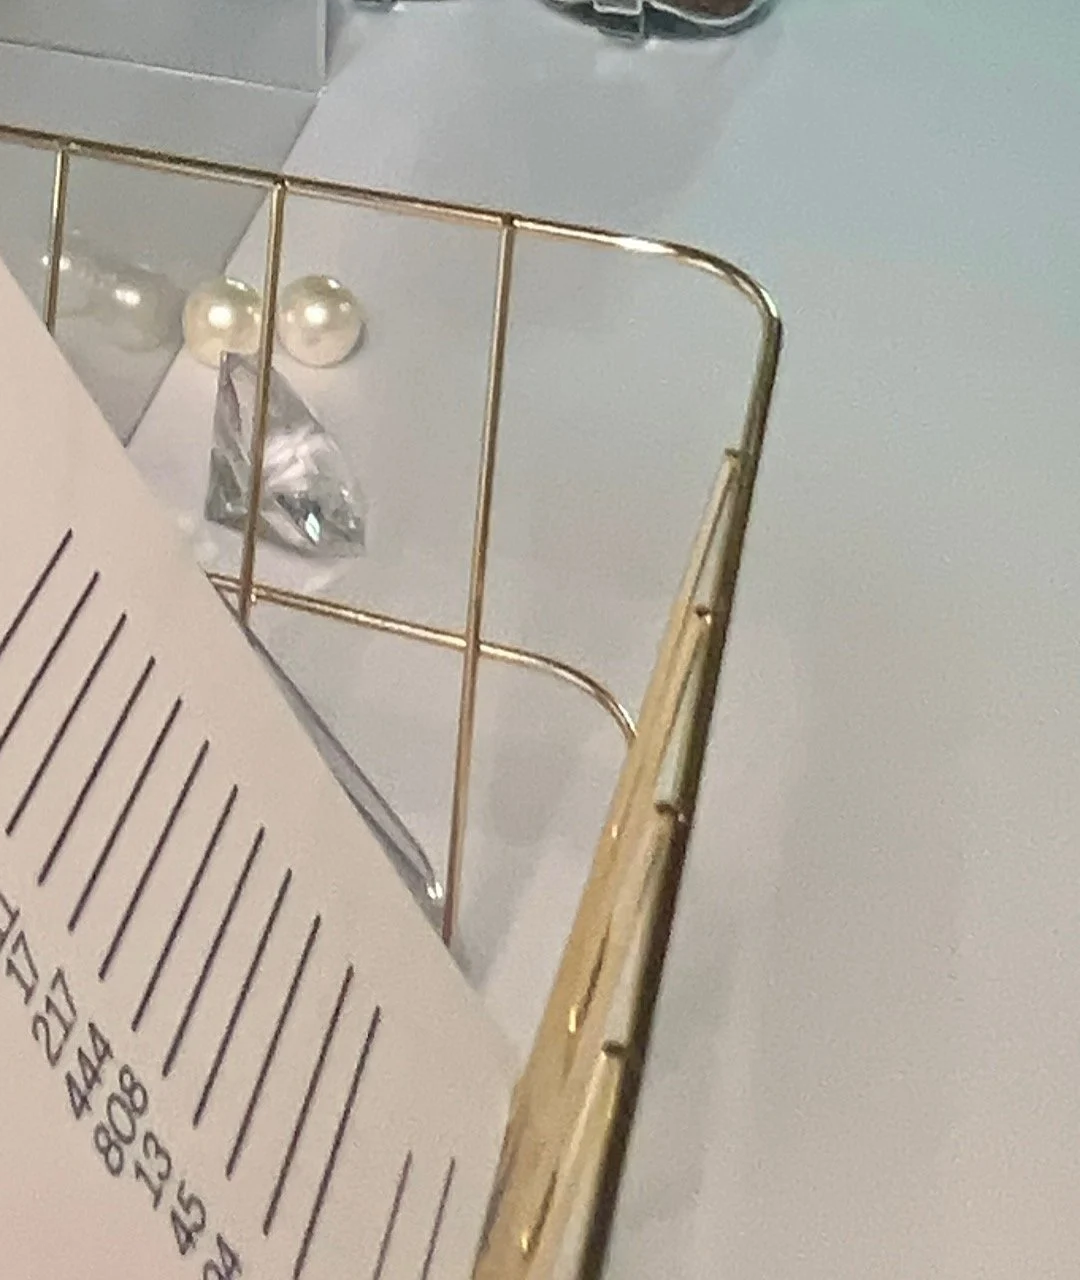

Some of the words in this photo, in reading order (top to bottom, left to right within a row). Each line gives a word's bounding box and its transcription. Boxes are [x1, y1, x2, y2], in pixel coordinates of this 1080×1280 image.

[5, 930, 40, 1006] 17
[31, 966, 78, 1068] 217
[65, 1021, 115, 1121] 444
[93, 1063, 149, 1177] 808
[134, 1130, 172, 1211] 13
[170, 1178, 207, 1256] 45
